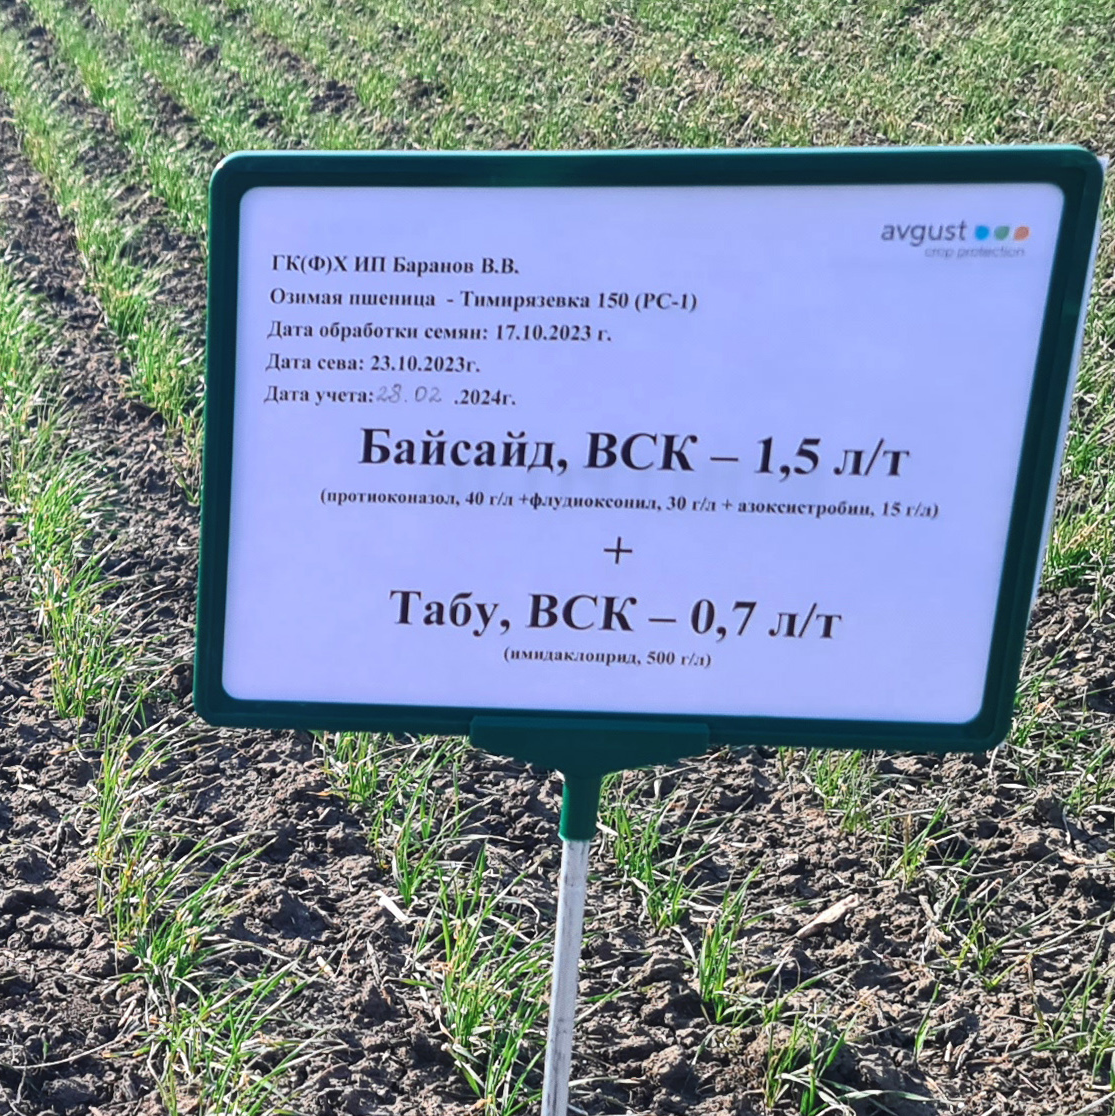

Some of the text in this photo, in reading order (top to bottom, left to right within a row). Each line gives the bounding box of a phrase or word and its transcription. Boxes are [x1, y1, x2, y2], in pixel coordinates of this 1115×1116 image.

[881, 219, 967, 247] avgust
[925, 246, 1025, 259] crop protection
[271, 254, 520, 278] ГК(Ф)Х ИП Баранов В.В.
[269, 287, 343, 306] Озимая
[349, 293, 436, 308] пшеница
[459, 290, 590, 312] Тимирязевка
[598, 293, 630, 309] 150
[634, 293, 698, 313] (РС-1)
[266, 320, 612, 343] Дата обработки семян: 17.10.2023 г.
[264, 352, 481, 373] Дата сева: 23.10.2023г.
[263, 384, 310, 404] Дата
[314, 390, 374, 406] учета:
[358, 428, 568, 477] Байсайд,
[583, 431, 699, 472] ВСК
[754, 436, 822, 483] 1,5
[832, 437, 911, 477] л/т
[320, 487, 460, 507] (протиоконазол,
[464, 491, 485, 506] 40
[488, 492, 514, 507] г/л
[518, 492, 662, 511] +флудиоксонил,
[665, 496, 687, 511] 30
[691, 496, 717, 512] г/л
[737, 500, 876, 519] азоксистробин,
[882, 501, 902, 517] 15
[905, 502, 940, 520] г/л)
[389, 589, 511, 638] Табу,
[526, 593, 638, 632] ВСК
[690, 598, 758, 643] 0,7
[768, 602, 843, 640] л/т
[503, 646, 712, 669] (имидаклоприд, 500 г/л)
